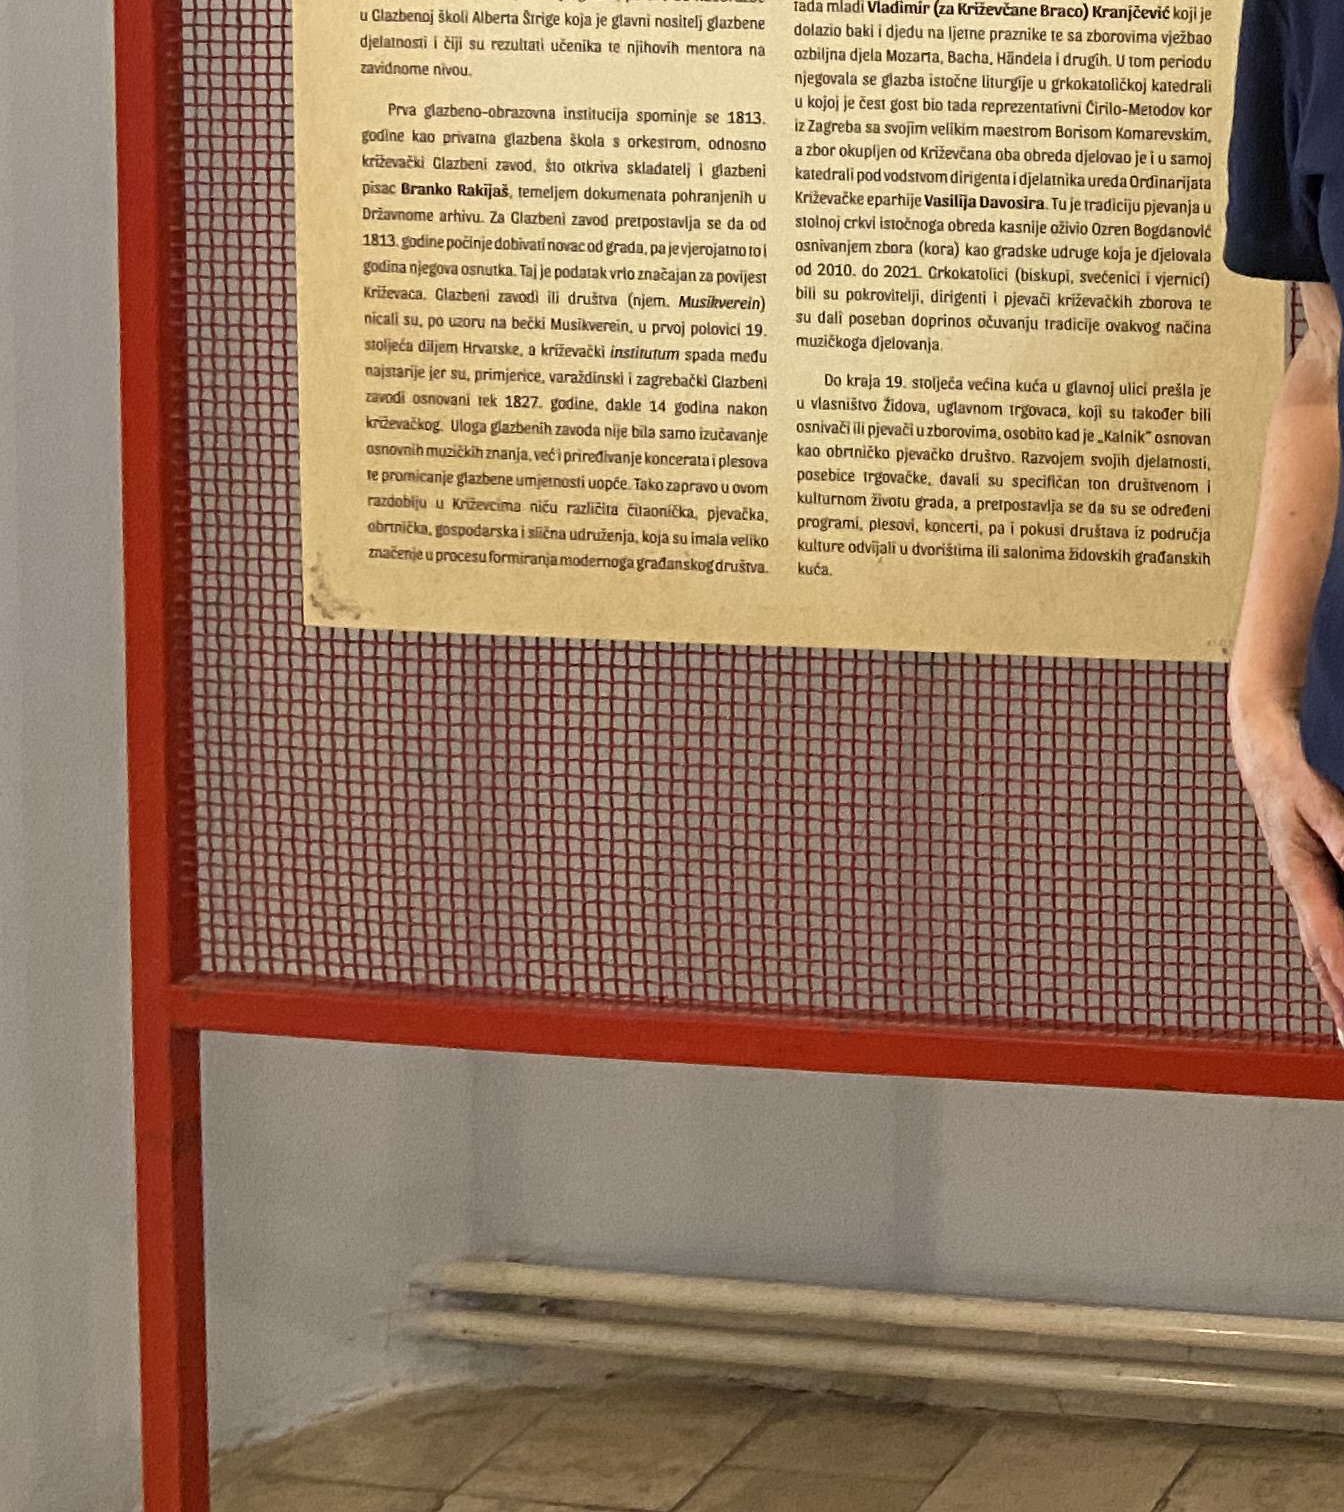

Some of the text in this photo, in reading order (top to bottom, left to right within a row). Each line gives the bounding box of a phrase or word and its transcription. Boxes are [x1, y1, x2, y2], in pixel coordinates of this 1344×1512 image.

[868, 0, 931, 15] Vladimir
[934, 0, 955, 18] (za
[958, 0, 1038, 16] Križevčane
[1041, 2, 1089, 21] Braco)
[1093, 4, 1171, 22] Kranjčević
[1173, 5, 1198, 23] koji
[1200, 6, 1212, 23] je
[825, 373, 842, 387] Do
[847, 372, 881, 390] kraja
[912, 375, 964, 393] stoljeća
[968, 376, 1011, 391] većina
[1016, 378, 1048, 392] kuća
[1053, 382, 1061, 394] u
[1066, 379, 1115, 398] glavnoj
[1120, 381, 1148, 396] ulici
[1153, 381, 1195, 399] prešla
[1200, 383, 1212, 400] je
